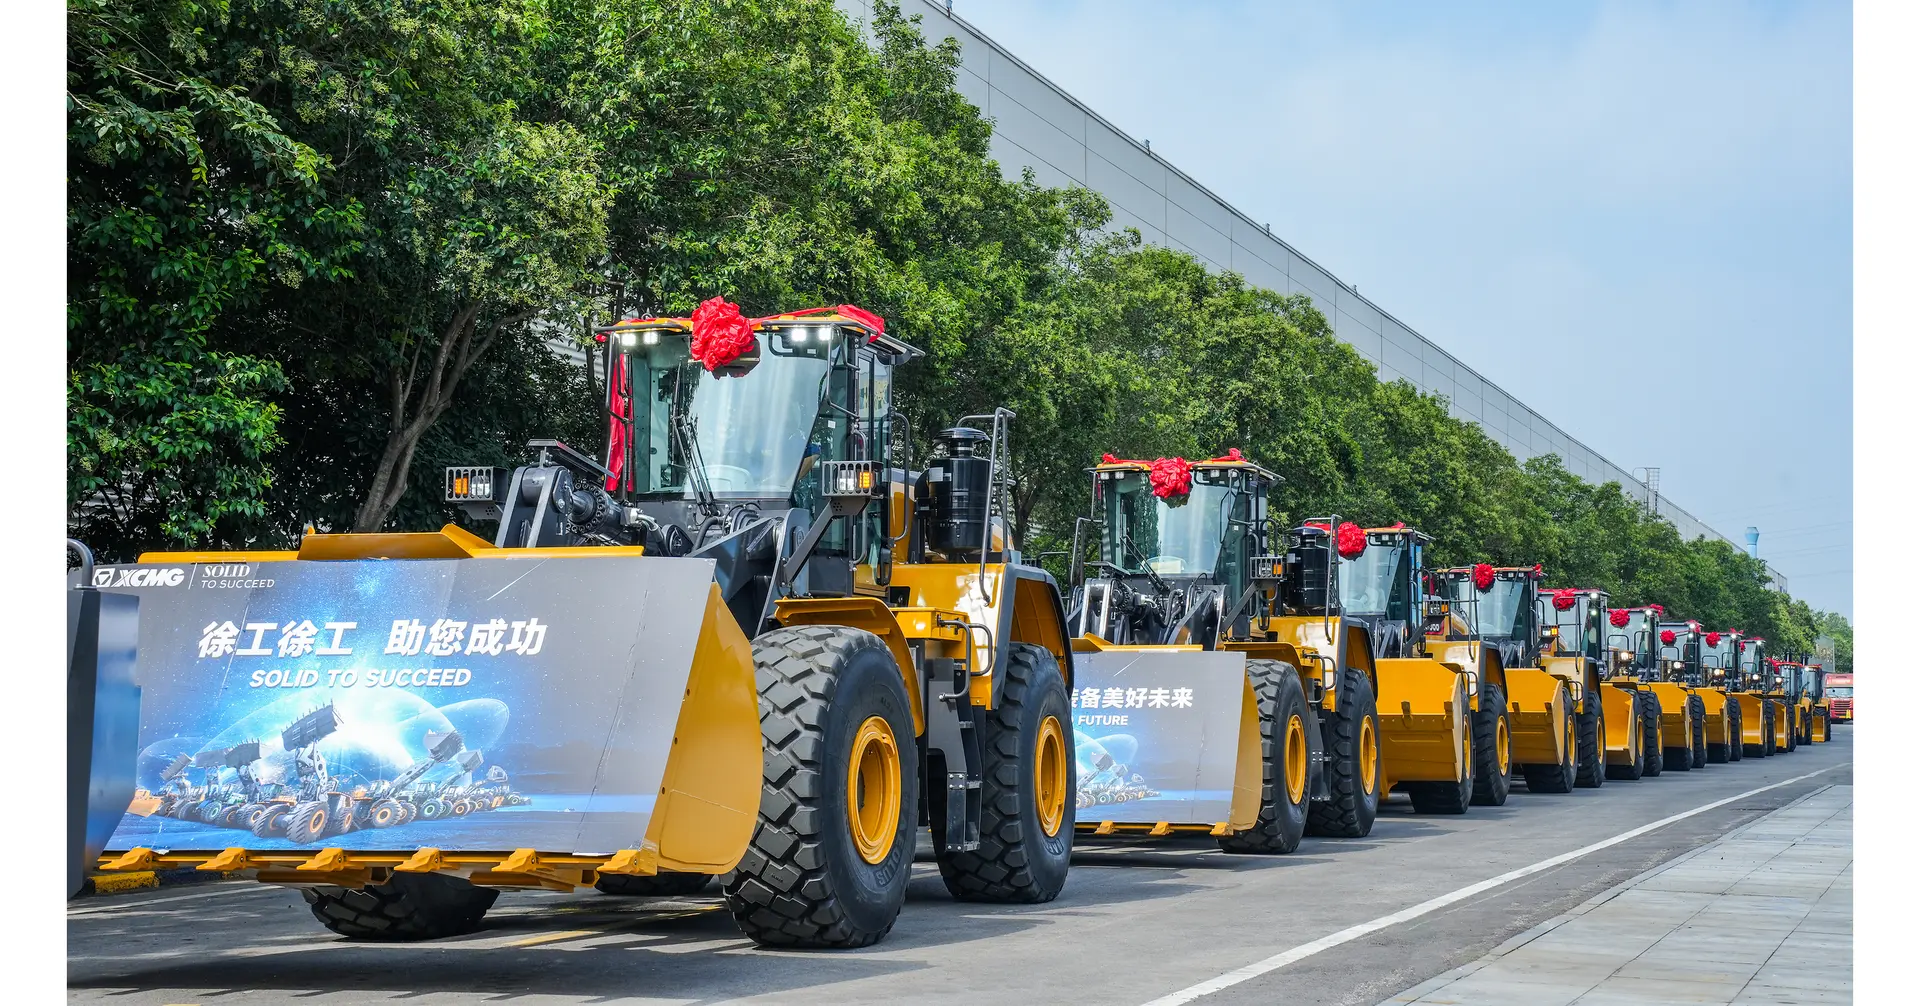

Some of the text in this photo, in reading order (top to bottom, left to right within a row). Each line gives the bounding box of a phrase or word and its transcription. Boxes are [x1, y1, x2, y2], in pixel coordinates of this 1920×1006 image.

[111, 568, 185, 587] XCMG
[202, 564, 250, 578] SOLID
[201, 579, 275, 589] TO SUCCEED
[198, 617, 549, 659] 徐工徐工 助您成功
[249, 668, 472, 688] SOLID TO SUCCEED
[1078, 715, 1129, 726] FUTURE
